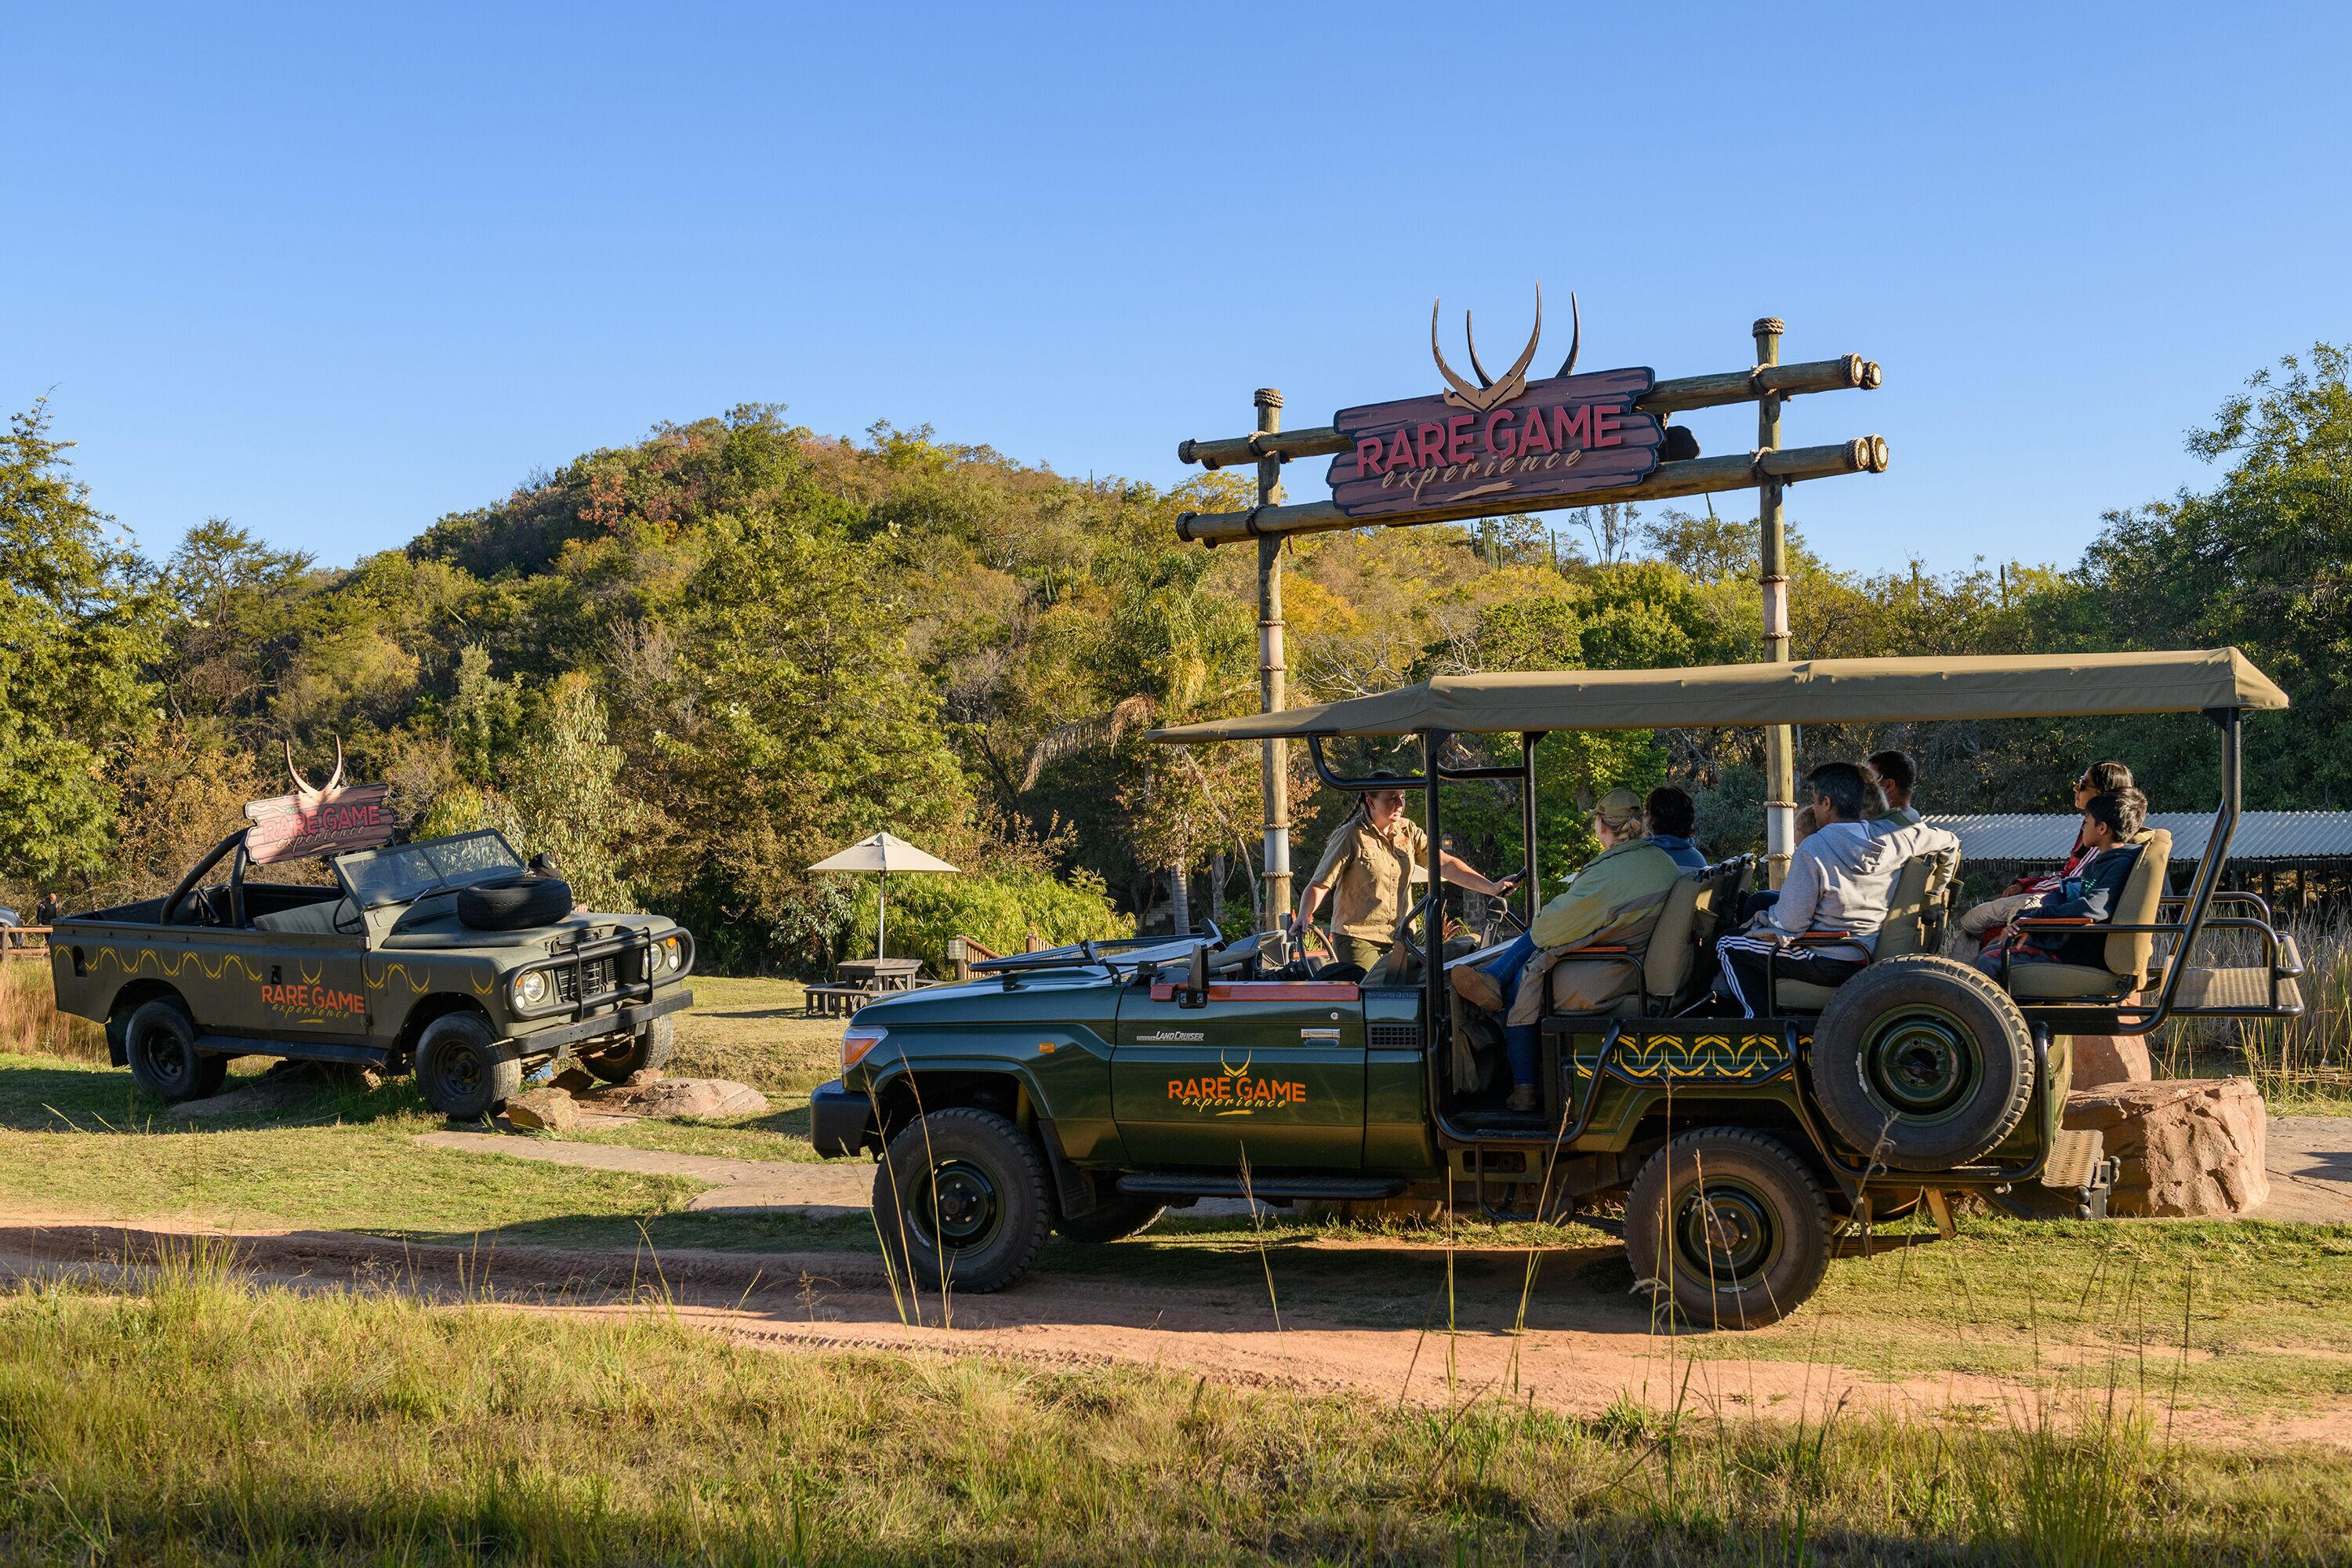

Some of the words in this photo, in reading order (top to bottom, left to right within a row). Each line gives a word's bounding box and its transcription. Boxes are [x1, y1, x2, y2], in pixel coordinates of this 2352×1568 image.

[1356, 413, 1475, 477] RARE
[1484, 404, 1622, 459] GAME
[1381, 448, 1584, 502] experience
[262, 809, 318, 844] RARE
[322, 804, 382, 832] GAME
[276, 825, 365, 853] experience
[261, 984, 309, 1007] RARE
[311, 986, 365, 1014] GAME
[271, 1003, 350, 1019] experience
[1167, 1076, 1232, 1100] RARE
[1236, 1076, 1306, 1103] GAME
[1182, 1096, 1287, 1113] experience
